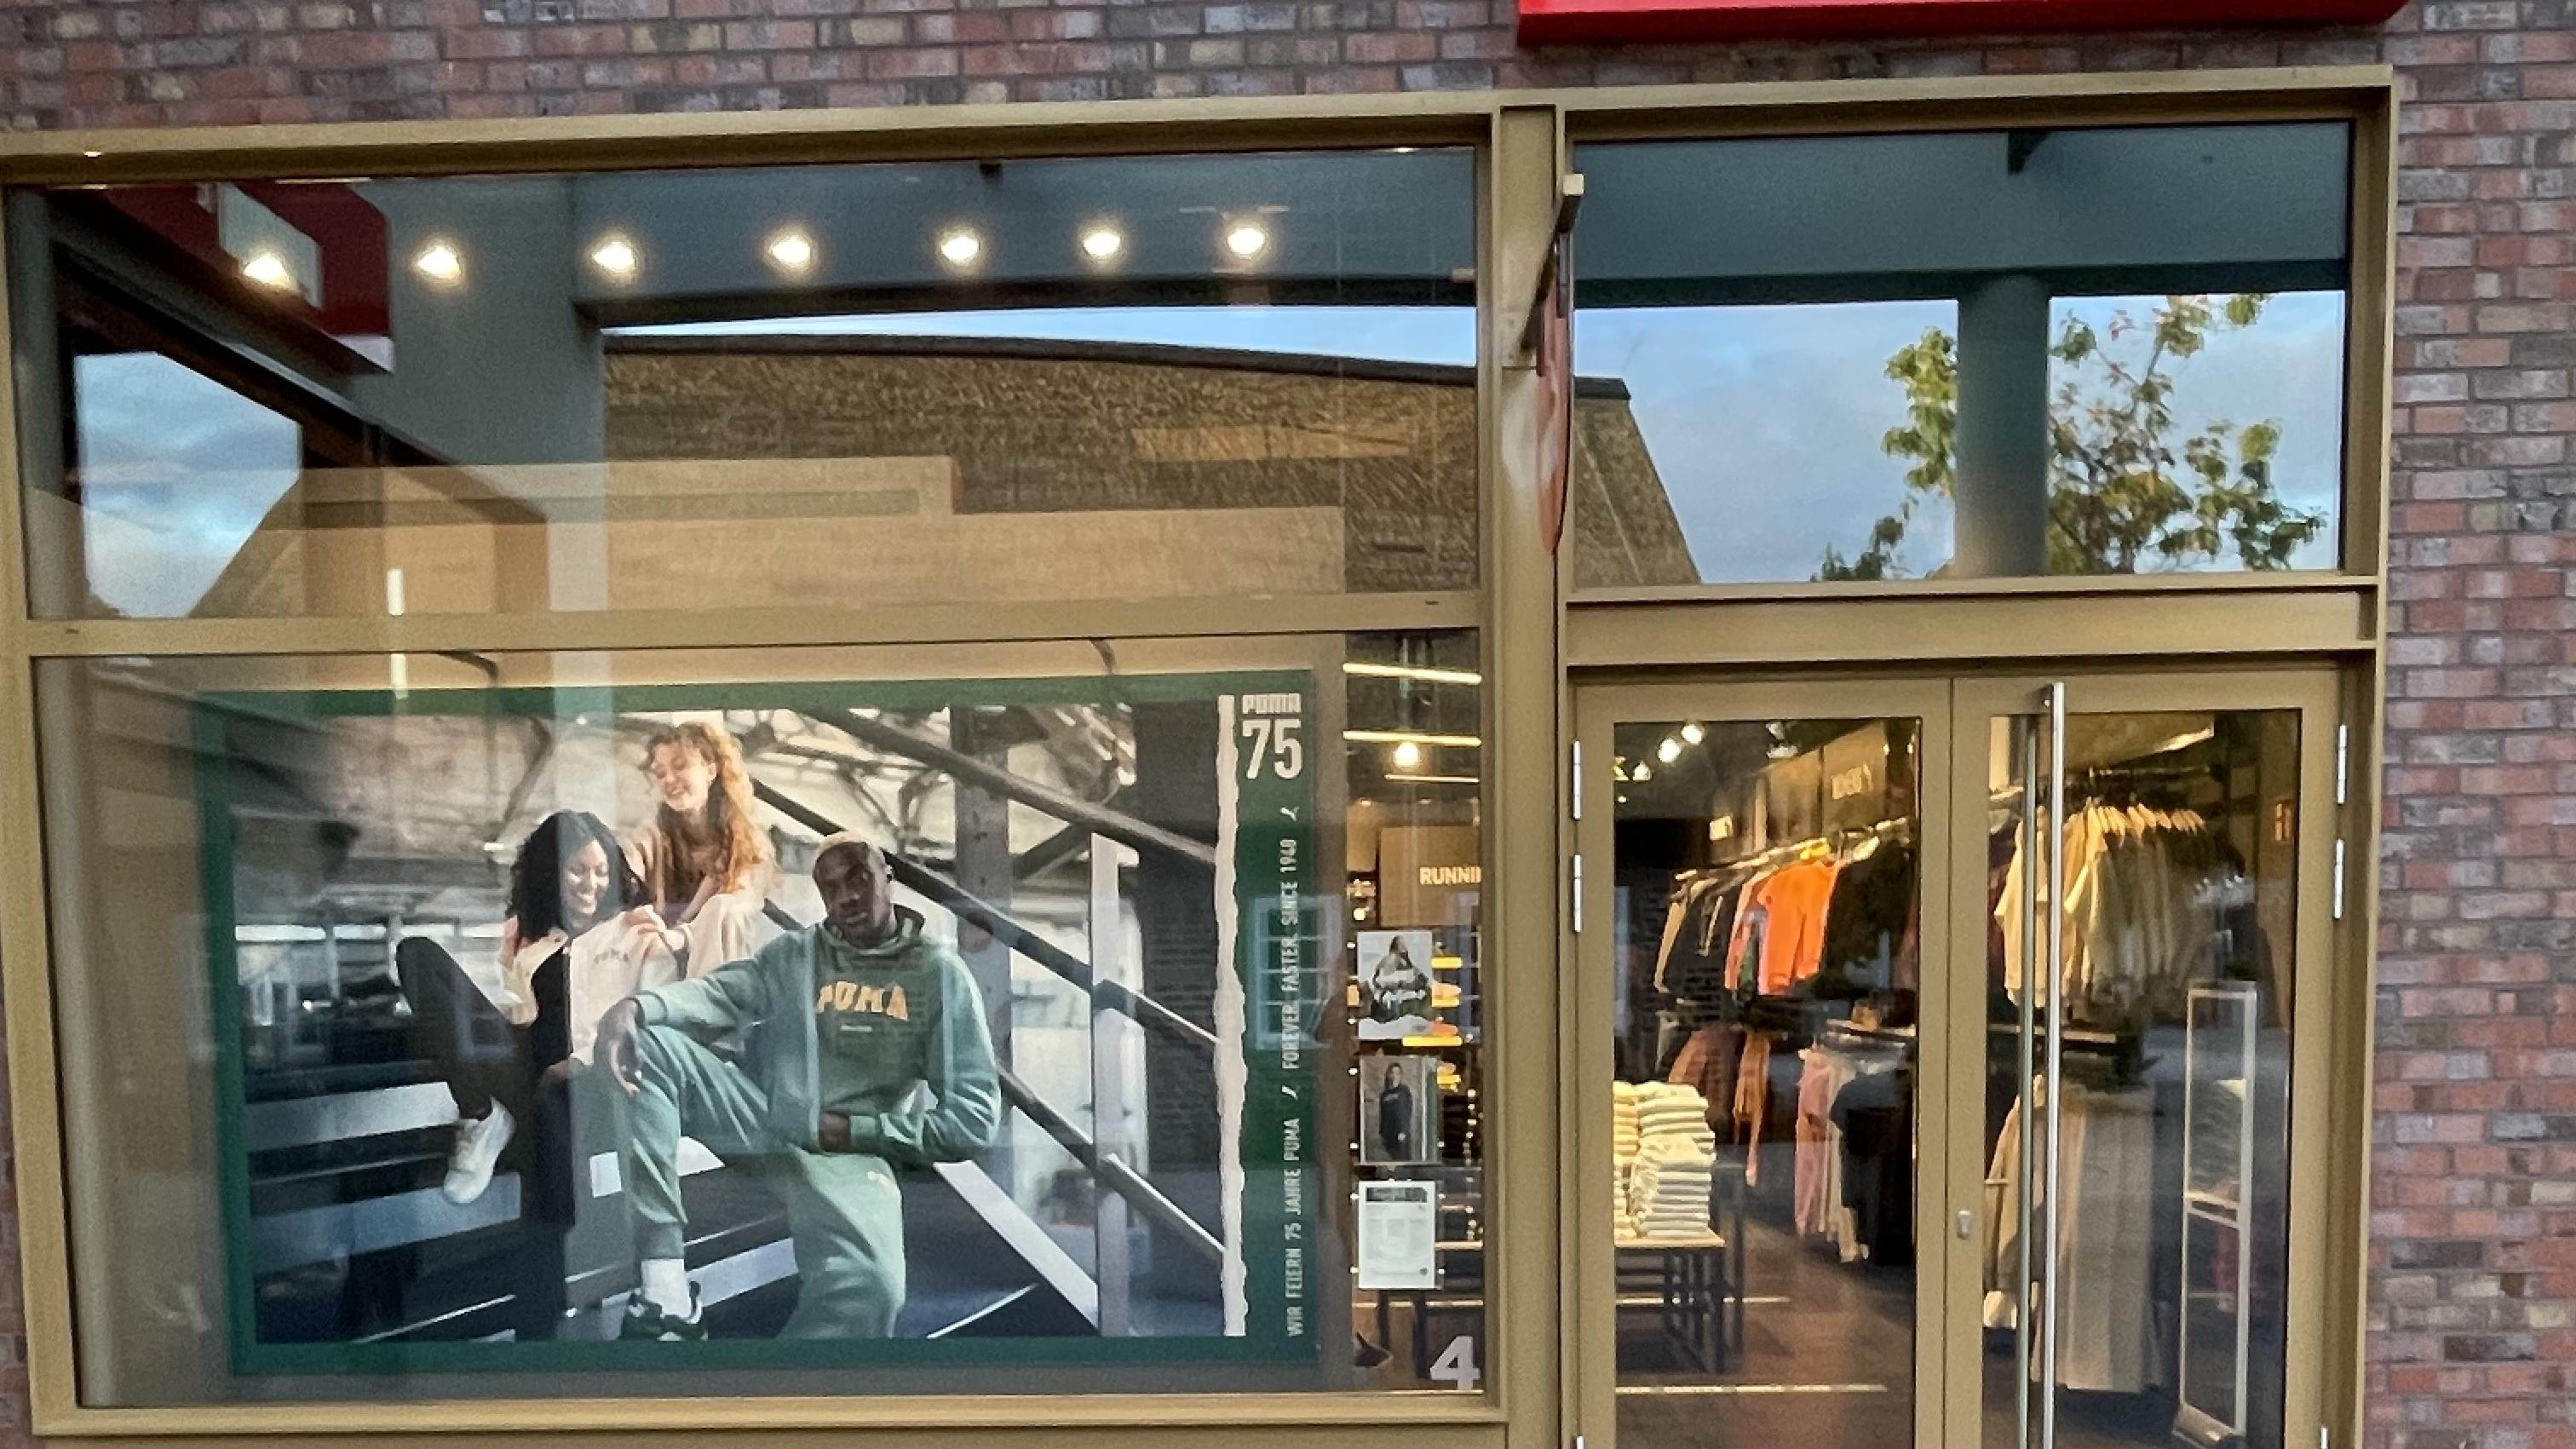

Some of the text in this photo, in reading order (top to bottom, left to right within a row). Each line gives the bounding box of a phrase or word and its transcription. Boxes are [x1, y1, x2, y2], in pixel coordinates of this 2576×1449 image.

[1242, 693, 1301, 714] PUMA
[1241, 718, 1302, 779] 75
[1280, 882, 1298, 926] SINCE
[816, 980, 909, 1021] PUMA
[1283, 1118, 1301, 1161] PUMA
[1284, 1168, 1302, 1216] JAHRE
[1284, 1222, 1302, 1240] 75
[1285, 1248, 1302, 1298] FEIERN
[1285, 1306, 1302, 1337] WIR
[1430, 1336, 1481, 1390] 4
